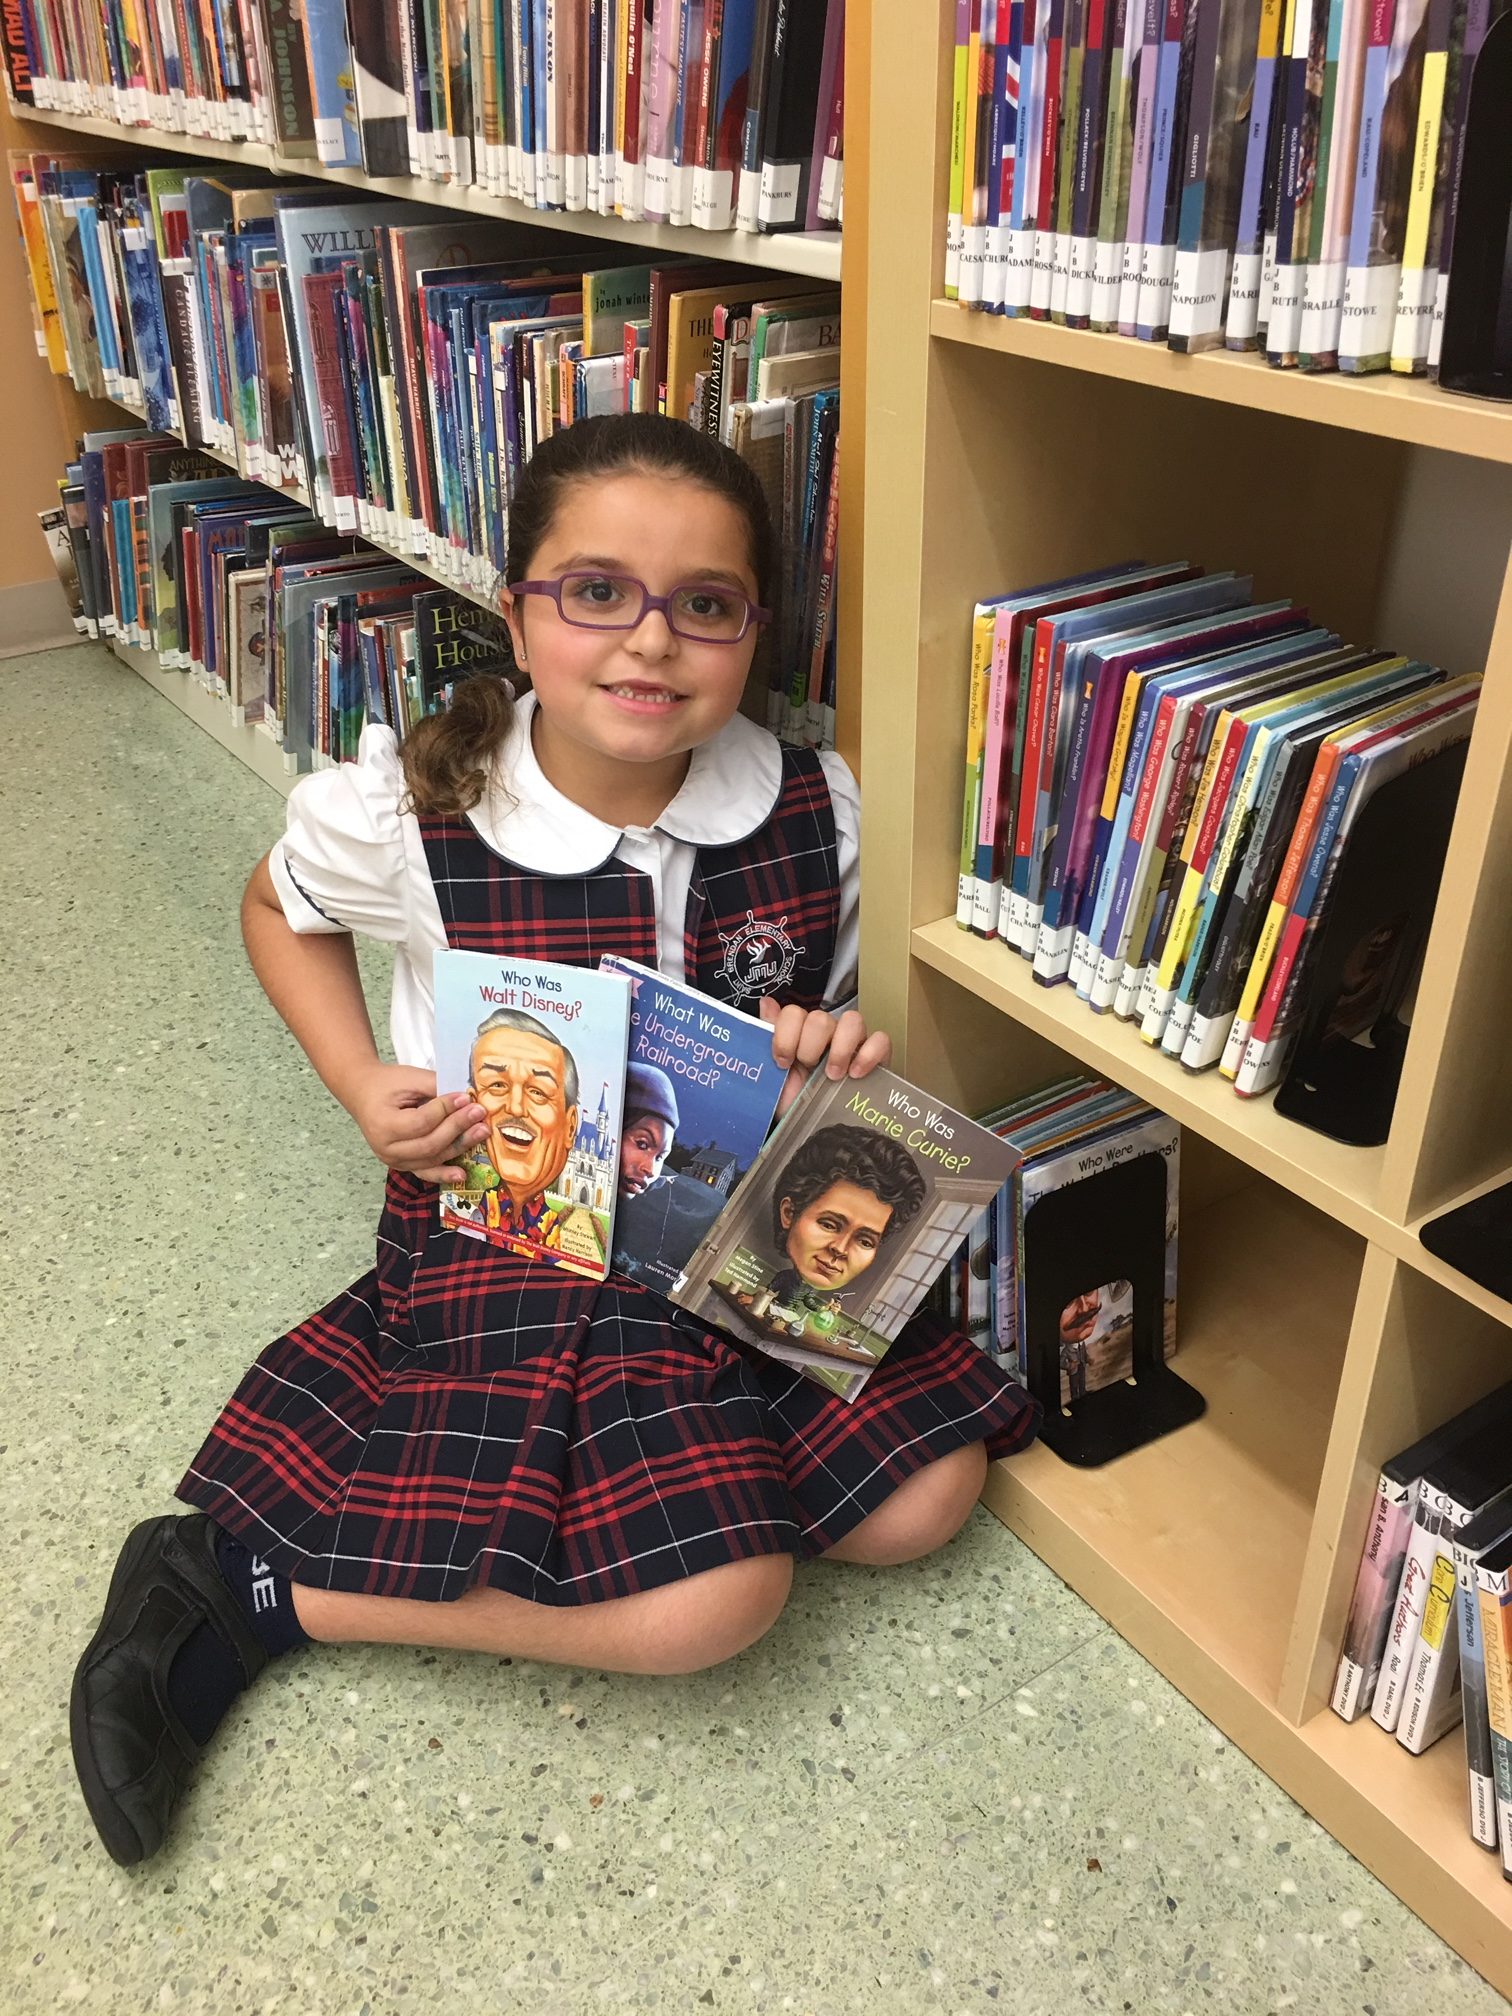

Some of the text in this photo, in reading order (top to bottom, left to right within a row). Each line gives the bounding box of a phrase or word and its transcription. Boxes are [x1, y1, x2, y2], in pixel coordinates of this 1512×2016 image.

[409, 20, 418, 72] MARCONI
[10, 52, 32, 90] ALI
[701, 30, 712, 108] JESSE OWENS
[272, 28, 300, 136] JOHNSON
[1190, 134, 1200, 178] GIGLIOTTI
[1286, 127, 1298, 198] HOLUB/HAMMOND
[596, 296, 622, 312] jonah
[1172, 294, 1216, 305] NAPOLEON
[1272, 296, 1298, 306] RUTH
[1302, 298, 1340, 311] BRAILLE
[1343, 306, 1378, 316] STOWE
[1396, 304, 1434, 316] REVERE
[176, 289, 190, 354] CANDACE
[184, 362, 202, 424] FLEMING
[409, 358, 422, 420] BRAVE HARRIET
[707, 341, 723, 437] EYEWITNESS
[812, 406, 821, 436] JOHN
[809, 441, 818, 473] SMITH
[814, 574, 830, 649] WILL SMITH
[1138, 710, 1150, 729] Who
[1134, 731, 1144, 748] Was
[1186, 727, 1195, 744] Who
[1180, 746, 1190, 763] Was
[1210, 738, 1222, 757] Who
[1226, 747, 1236, 764] Who
[1204, 759, 1217, 776] Was
[1220, 766, 1231, 782] Was
[1248, 755, 1260, 773] Who
[1134, 719, 1167, 842] Who Was George Washington?
[1242, 776, 1252, 794] Was
[1272, 770, 1283, 788] Who
[1313, 774, 1326, 793] Who
[1266, 790, 1277, 806] Was
[1305, 796, 1318, 814] Was
[1334, 785, 1346, 802] Who
[1228, 795, 1248, 846] Christopher
[1327, 805, 1339, 820] Was
[1294, 814, 1312, 850] Thomas
[1320, 822, 1334, 846] Jesse
[745, 925, 791, 950] ELEMENTARY
[727, 935, 744, 973] BRENDAN
[502, 970, 562, 992] Who Was
[733, 979, 752, 994] SAINT
[480, 985, 582, 1022] Walt Disney?
[655, 992, 695, 1024] What
[700, 1012, 731, 1042] Was
[644, 1012, 764, 1082] Underground
[636, 1034, 720, 1089] Railroad?
[888, 1089, 955, 1140] Who Was
[844, 1091, 971, 1174] Marie Curie?
[1078, 1156, 1102, 1172] Who
[1106, 1144, 1134, 1161] Were
[644, 1262, 664, 1278] Lauren
[734, 1256, 752, 1267] Megan
[1394, 1490, 1409, 1502] A
[1370, 1524, 1384, 1562] Anthony
[1487, 1573, 1507, 1592] M
[1394, 1557, 1426, 1647] Great Authors
[1464, 1598, 1475, 1648] Jefferson
[1416, 1650, 1432, 1688] Thomas
[1388, 1685, 1396, 1702] DAHL
[1410, 1703, 1420, 1726] EDISON
[1478, 1782, 1488, 1836] JEFFERSO DVD
